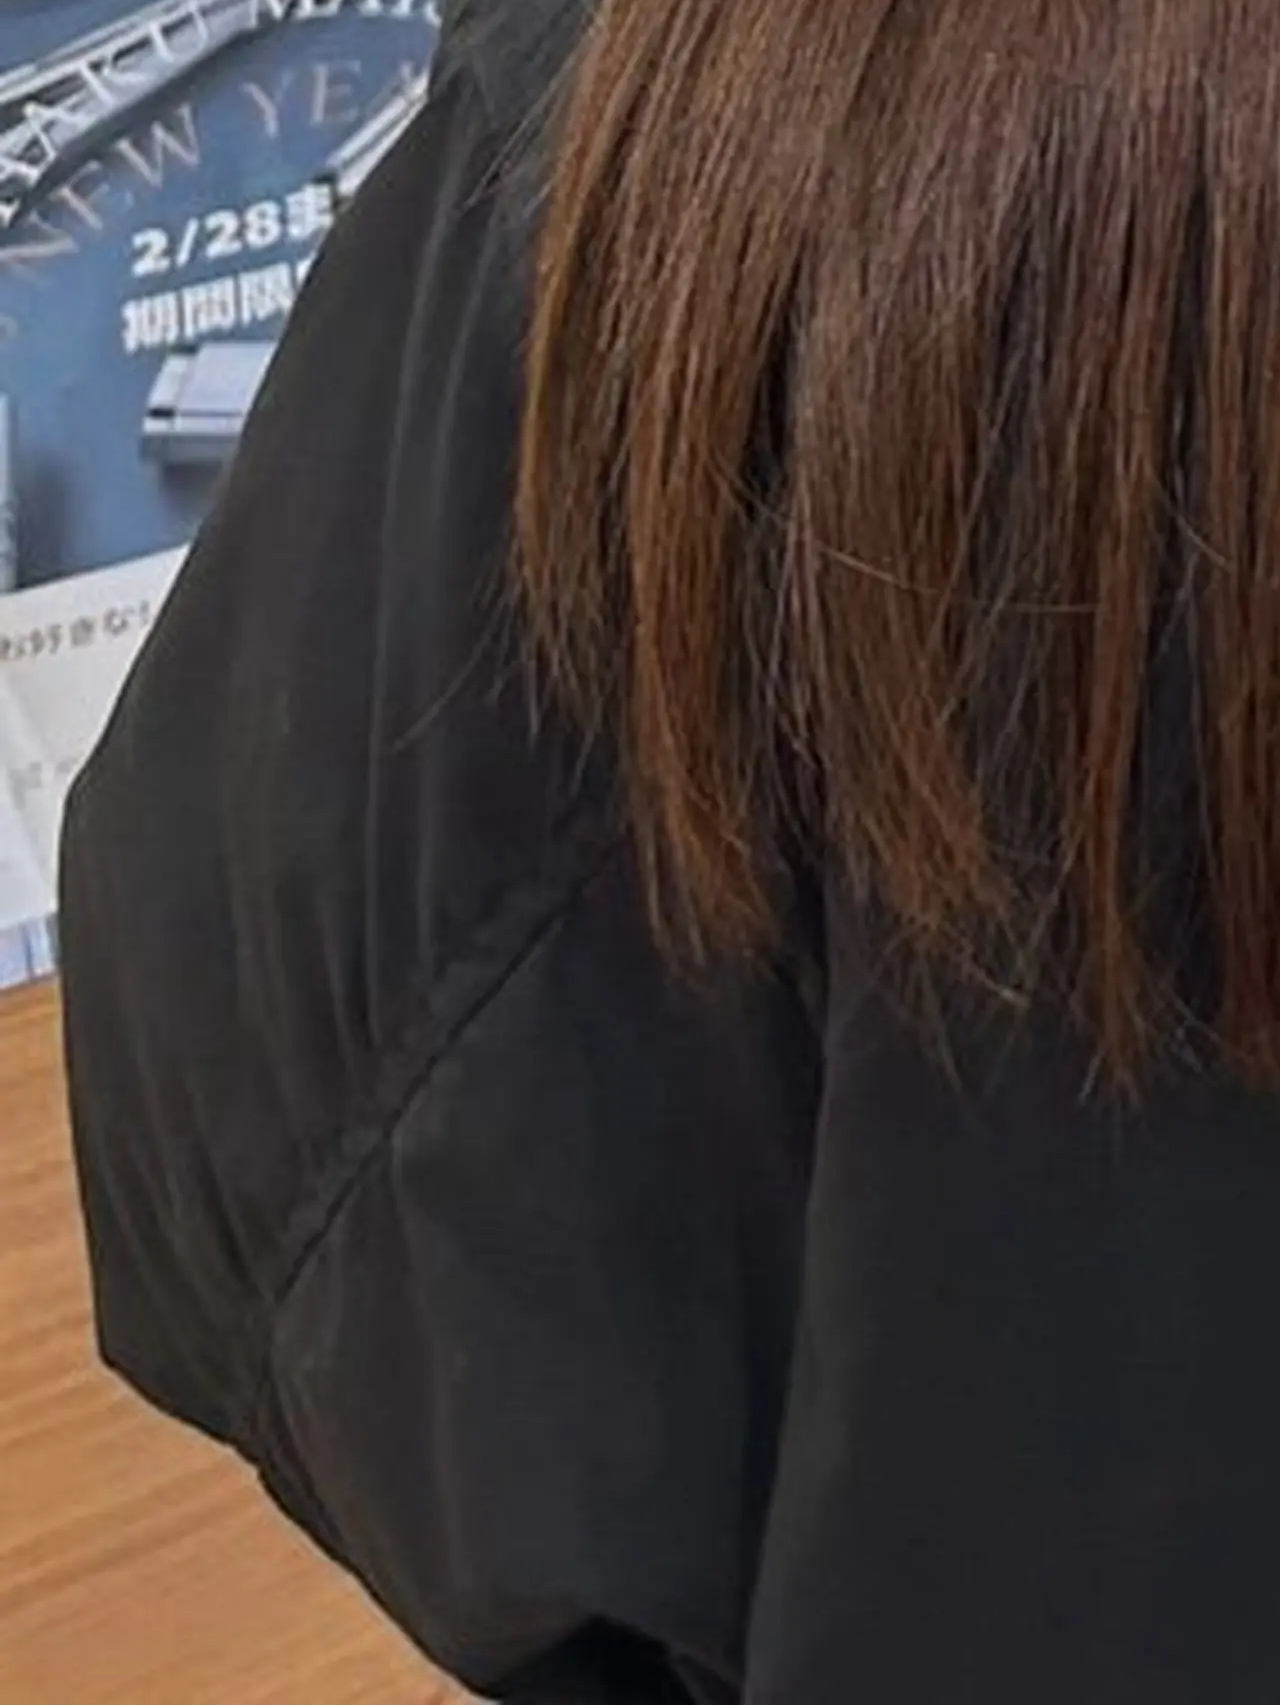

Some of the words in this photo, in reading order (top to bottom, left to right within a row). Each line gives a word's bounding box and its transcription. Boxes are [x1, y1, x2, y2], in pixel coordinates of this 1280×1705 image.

[0, 101, 202, 288] NEW
[121, 255, 315, 356] 期間限
